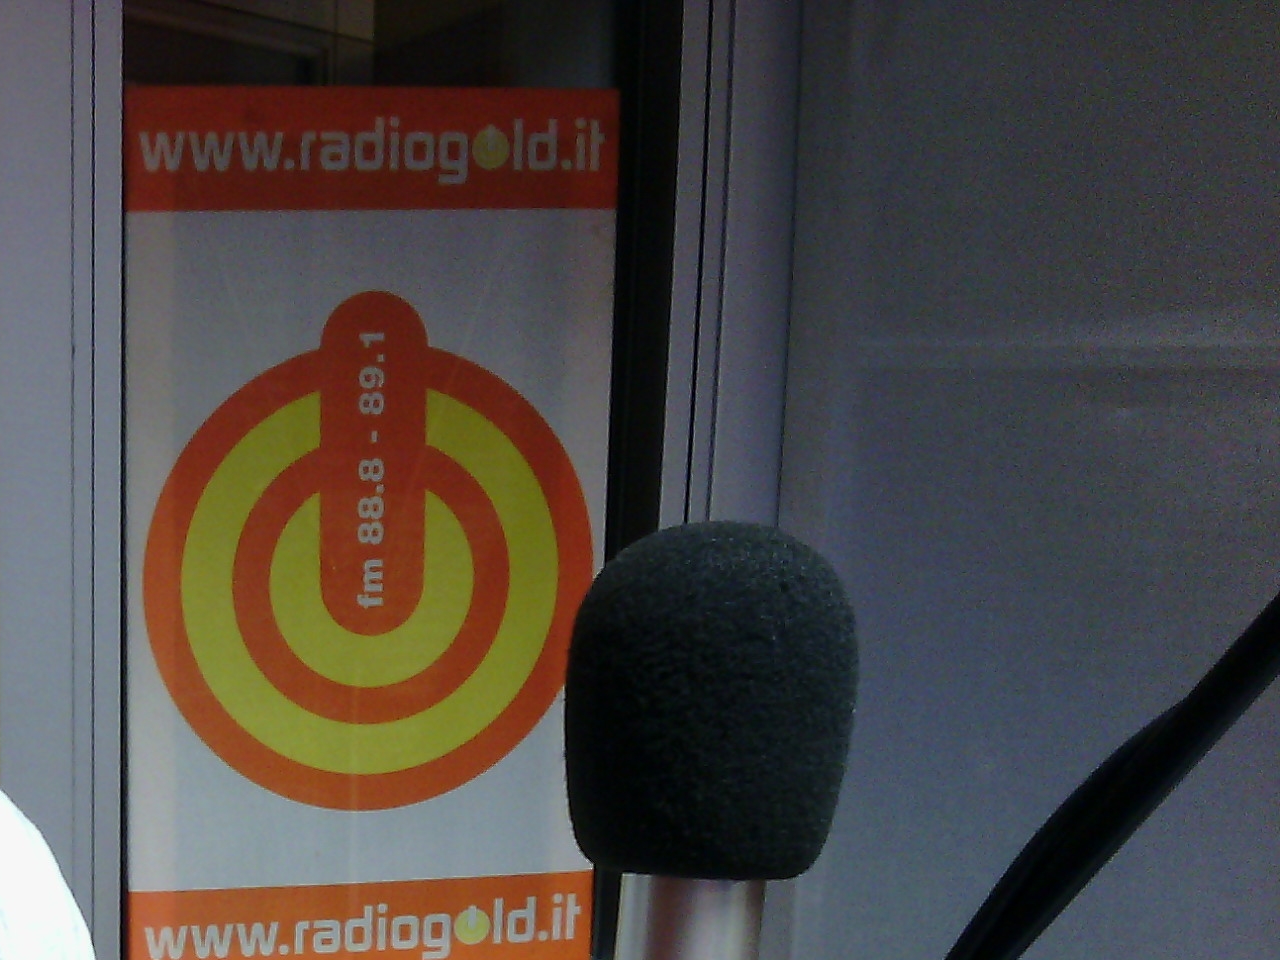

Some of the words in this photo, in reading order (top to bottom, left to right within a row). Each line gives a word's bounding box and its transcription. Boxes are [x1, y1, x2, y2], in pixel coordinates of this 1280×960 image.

[139, 116, 605, 185] www.radiogold.it
[358, 331, 385, 416] 89.1
[357, 458, 385, 545] 88.8
[357, 558, 384, 609] fm
